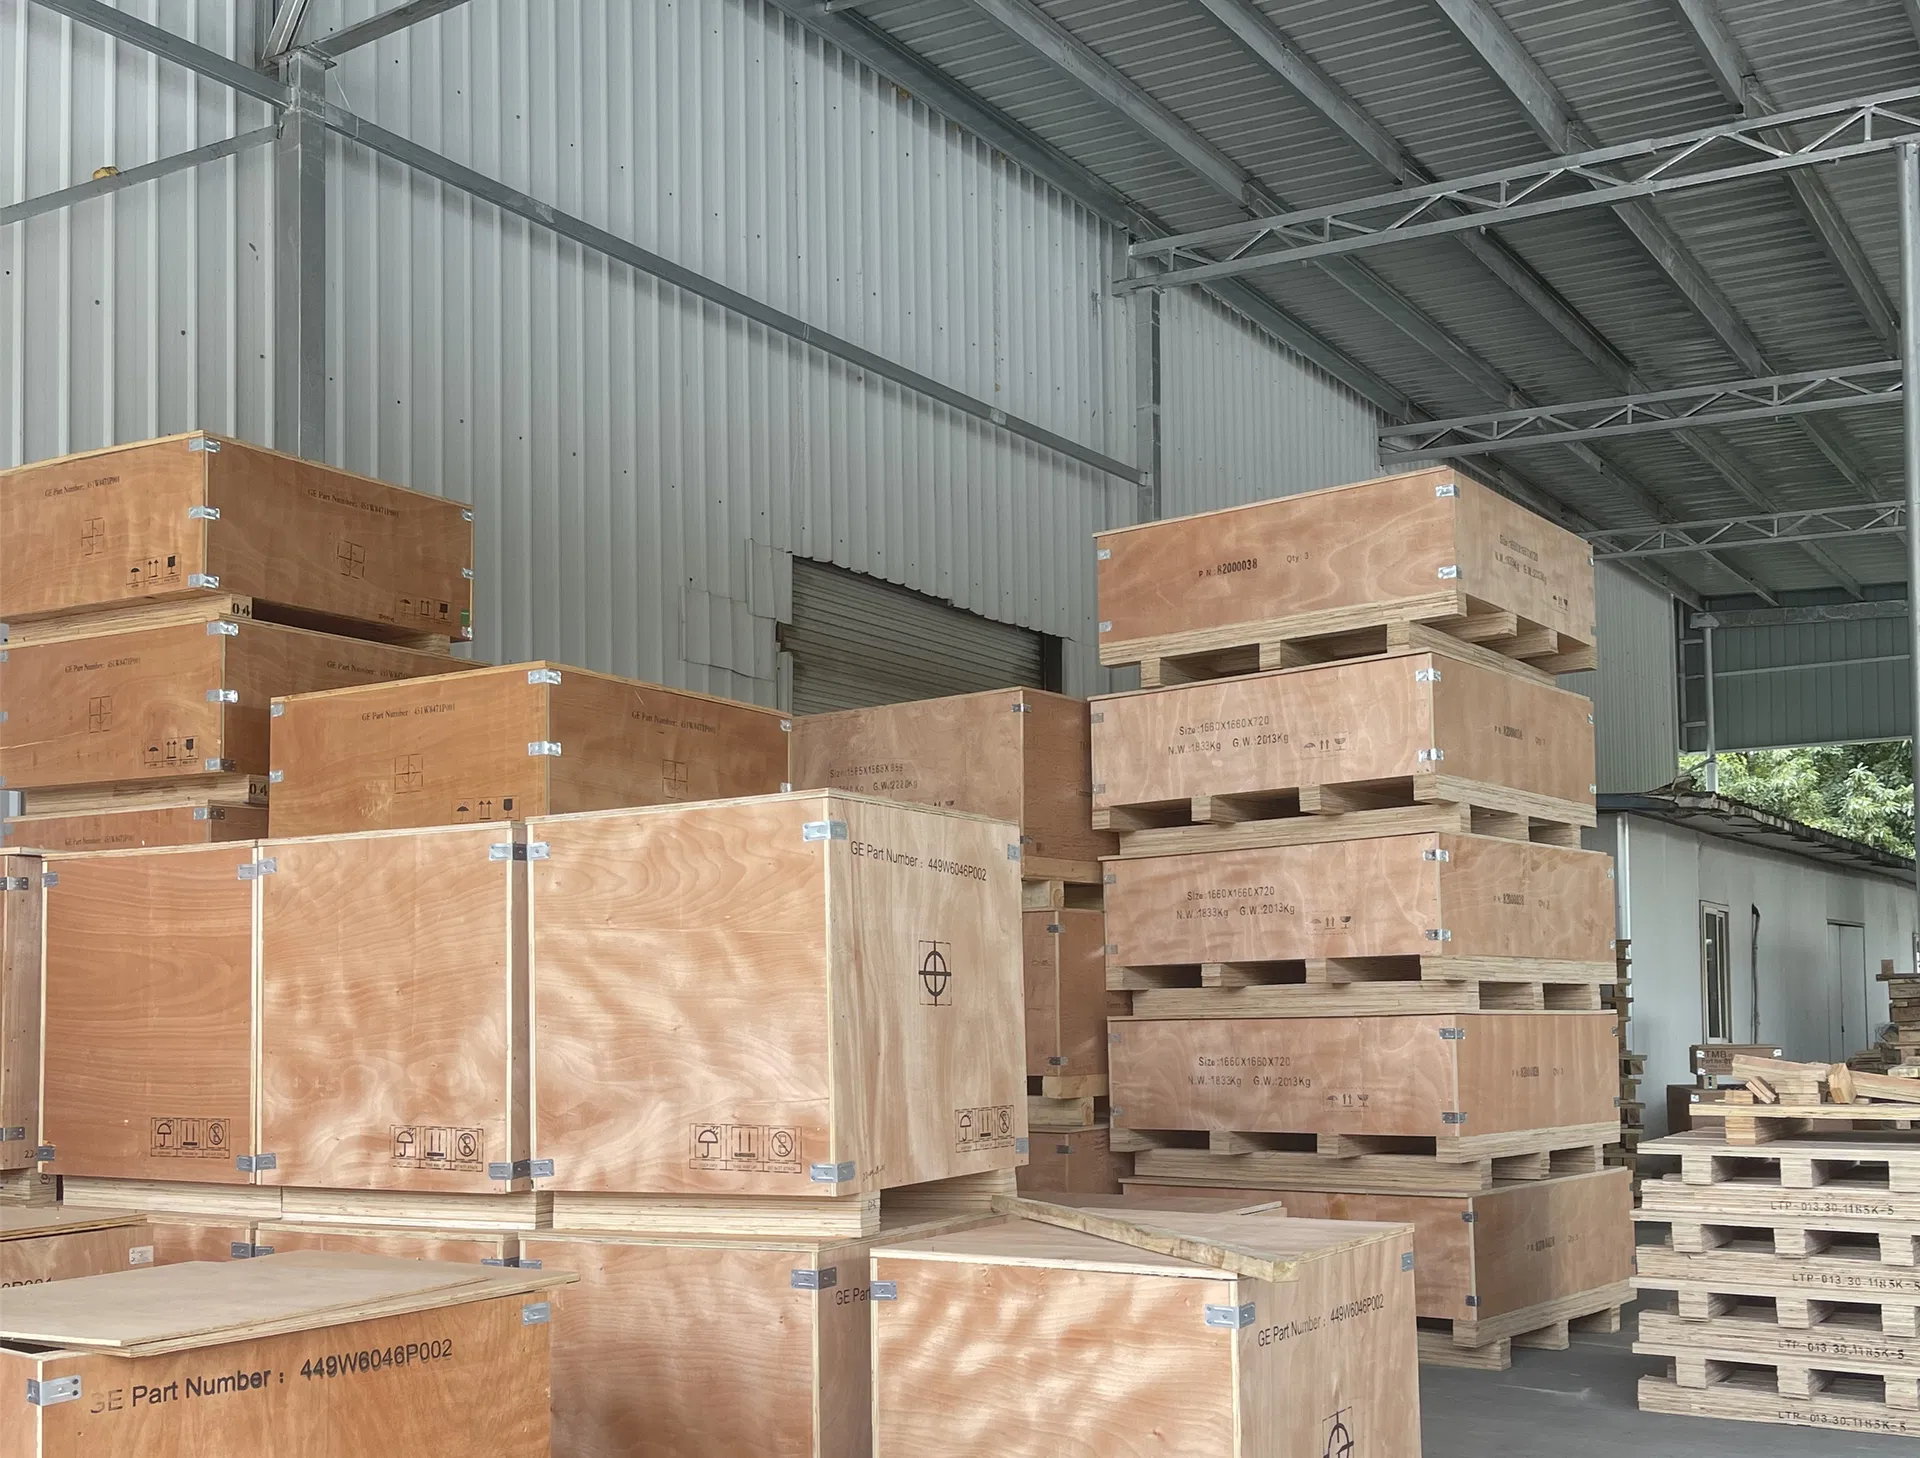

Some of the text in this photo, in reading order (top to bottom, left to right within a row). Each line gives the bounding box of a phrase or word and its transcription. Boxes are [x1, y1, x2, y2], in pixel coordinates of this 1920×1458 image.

[232, 602, 251, 617] 04
[850, 840, 865, 857] GE
[866, 843, 885, 861] Part
[927, 858, 987, 881] 449W6046P002
[835, 1289, 850, 1306] GE
[1257, 1328, 1271, 1347] GE
[1273, 1324, 1290, 1343] Part
[1330, 1293, 1384, 1324] 449W6046P002
[132, 1382, 178, 1408] Part
[300, 1338, 453, 1380] 449W6046P002
